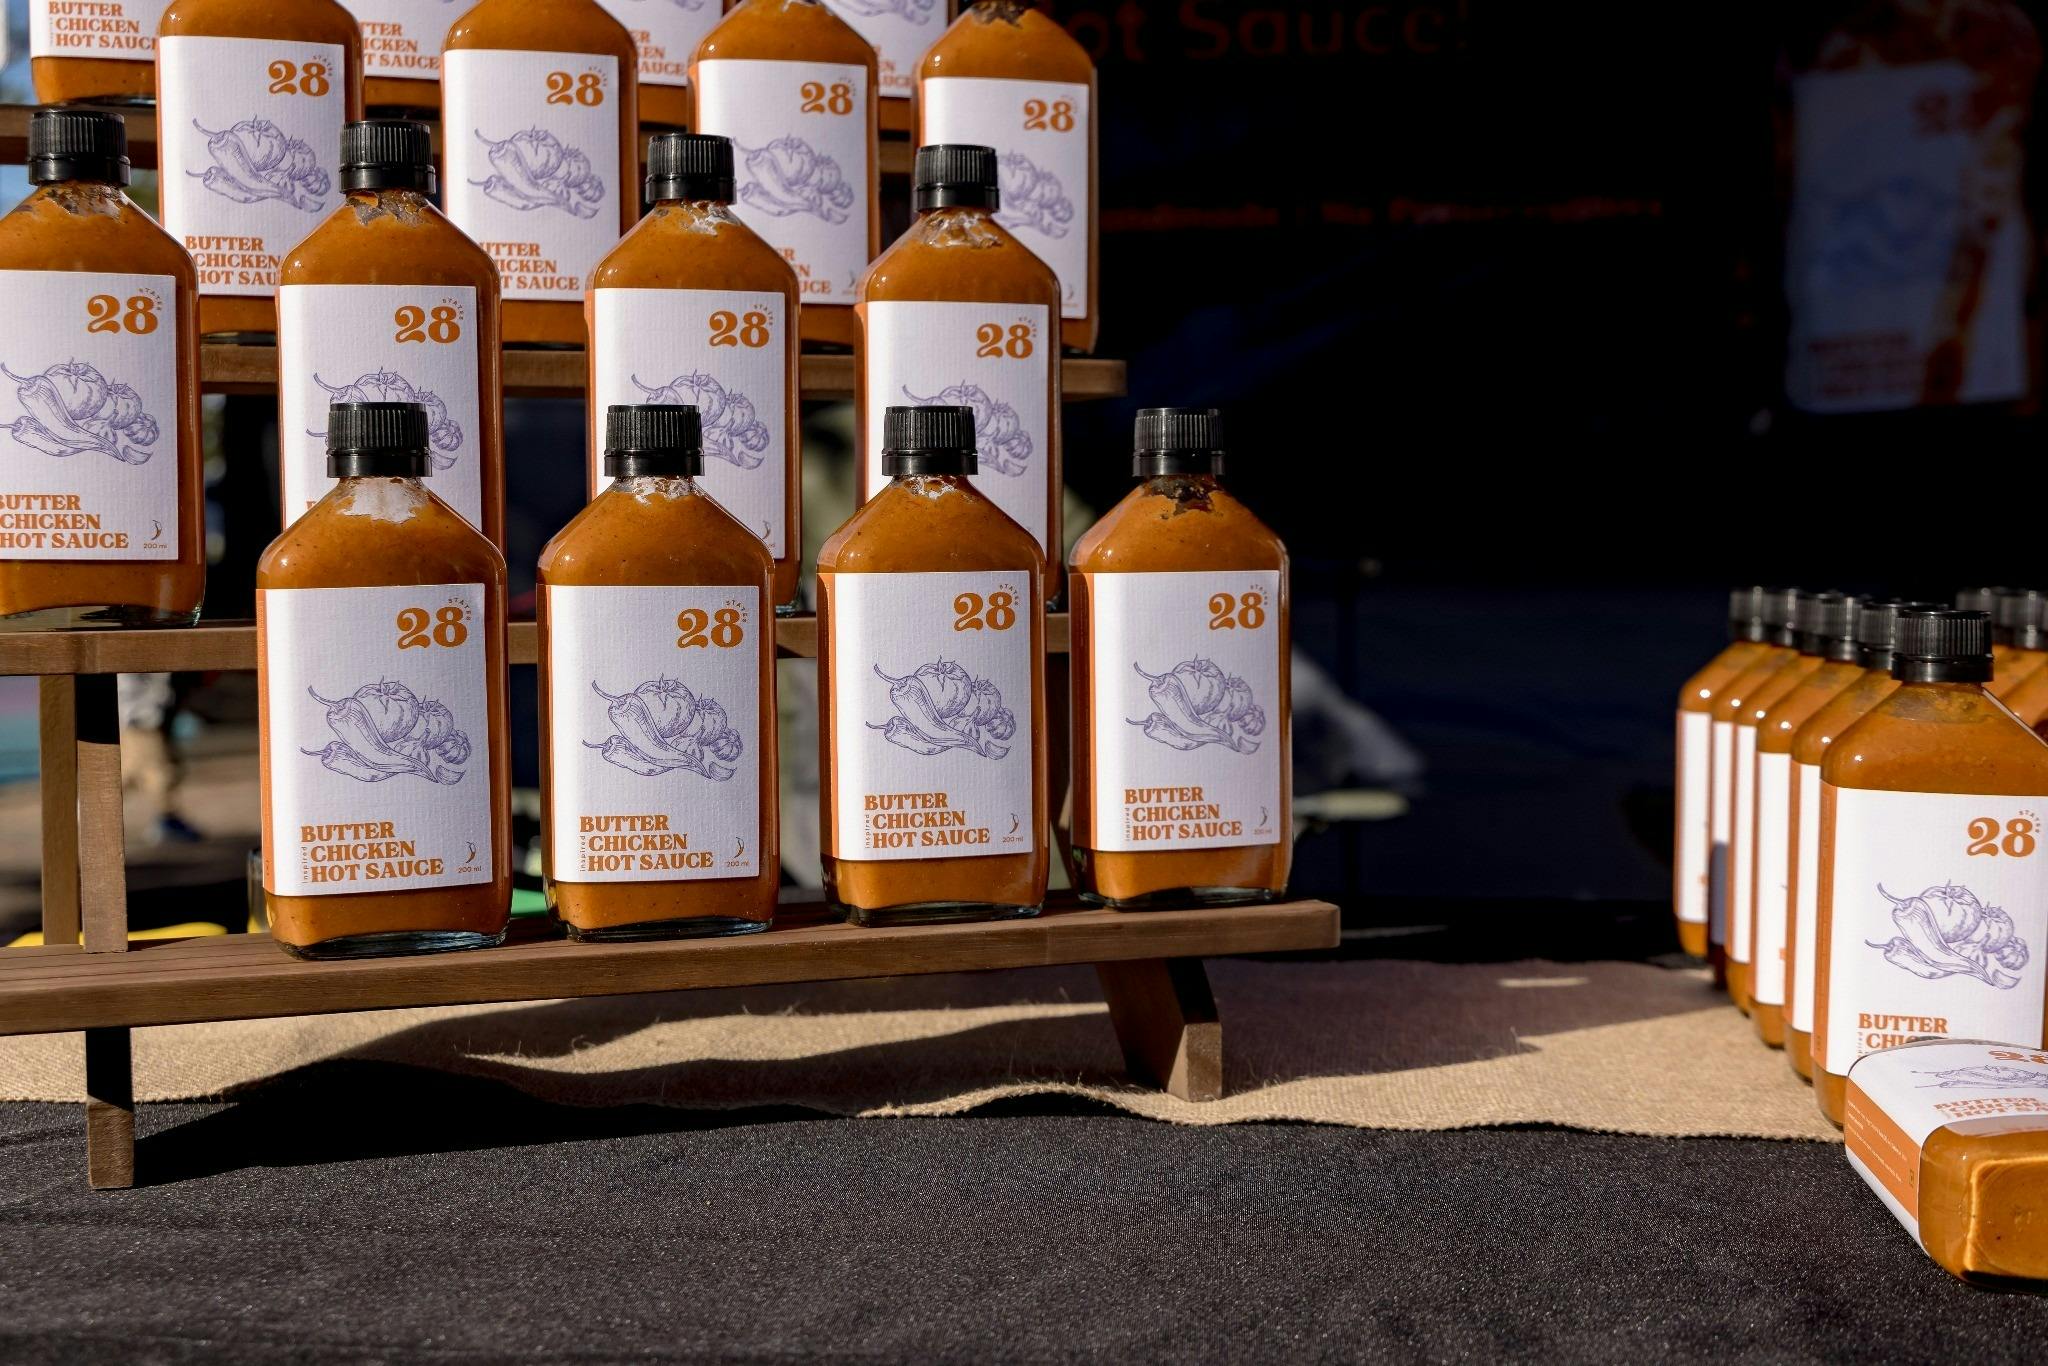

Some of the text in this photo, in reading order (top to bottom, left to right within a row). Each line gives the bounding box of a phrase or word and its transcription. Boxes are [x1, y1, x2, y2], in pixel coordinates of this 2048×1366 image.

[48, 1, 123, 16] BUTTER
[55, 17, 140, 33] CHICKEN
[1064, 0, 1152, 63] ot
[55, 33, 95, 48] HOT
[364, 37, 418, 53] ICKEN
[268, 60, 330, 96] 28
[639, 60, 687, 77] AUCE
[546, 70, 604, 107] 28
[800, 82, 853, 115] 28
[1023, 99, 1074, 133] 28
[184, 235, 264, 252] BUTTER
[481, 242, 541, 257] UTTER
[194, 253, 281, 269] CHICKEN
[238, 270, 276, 286] SAU
[516, 275, 580, 291] SAUCE
[88, 294, 158, 335] 28
[395, 305, 461, 344] 28
[710, 310, 770, 348] 28
[976, 323, 1034, 359] 28
[0, 513, 102, 530] CHICKEN
[0, 532, 129, 549] HOT SAUCE
[448, 597, 472, 621] STATES
[726, 600, 748, 623] STATES
[953, 592, 1016, 631] 28
[1209, 592, 1265, 630] 28
[397, 607, 468, 650] 28
[677, 608, 744, 649] 28
[864, 792, 948, 811] BUTTER
[1124, 786, 1204, 804] BUTTER
[579, 814, 670, 833] BUTTER
[872, 810, 966, 829] CHICKEN
[1132, 804, 1220, 822] CHICKEN
[301, 821, 395, 843] BUTTER
[872, 828, 990, 849] HOT SAUCE
[1132, 821, 1243, 841] HOT SAUCE
[1967, 816, 2036, 858] 28
[310, 840, 416, 863] CHICKEN
[587, 833, 688, 852] CHICKEN
[310, 858, 445, 883] HOT SAUCE
[458, 866, 472, 874] 200
[587, 851, 714, 872] HOT SAUCE
[1858, 1012, 1949, 1034] BUTTER
